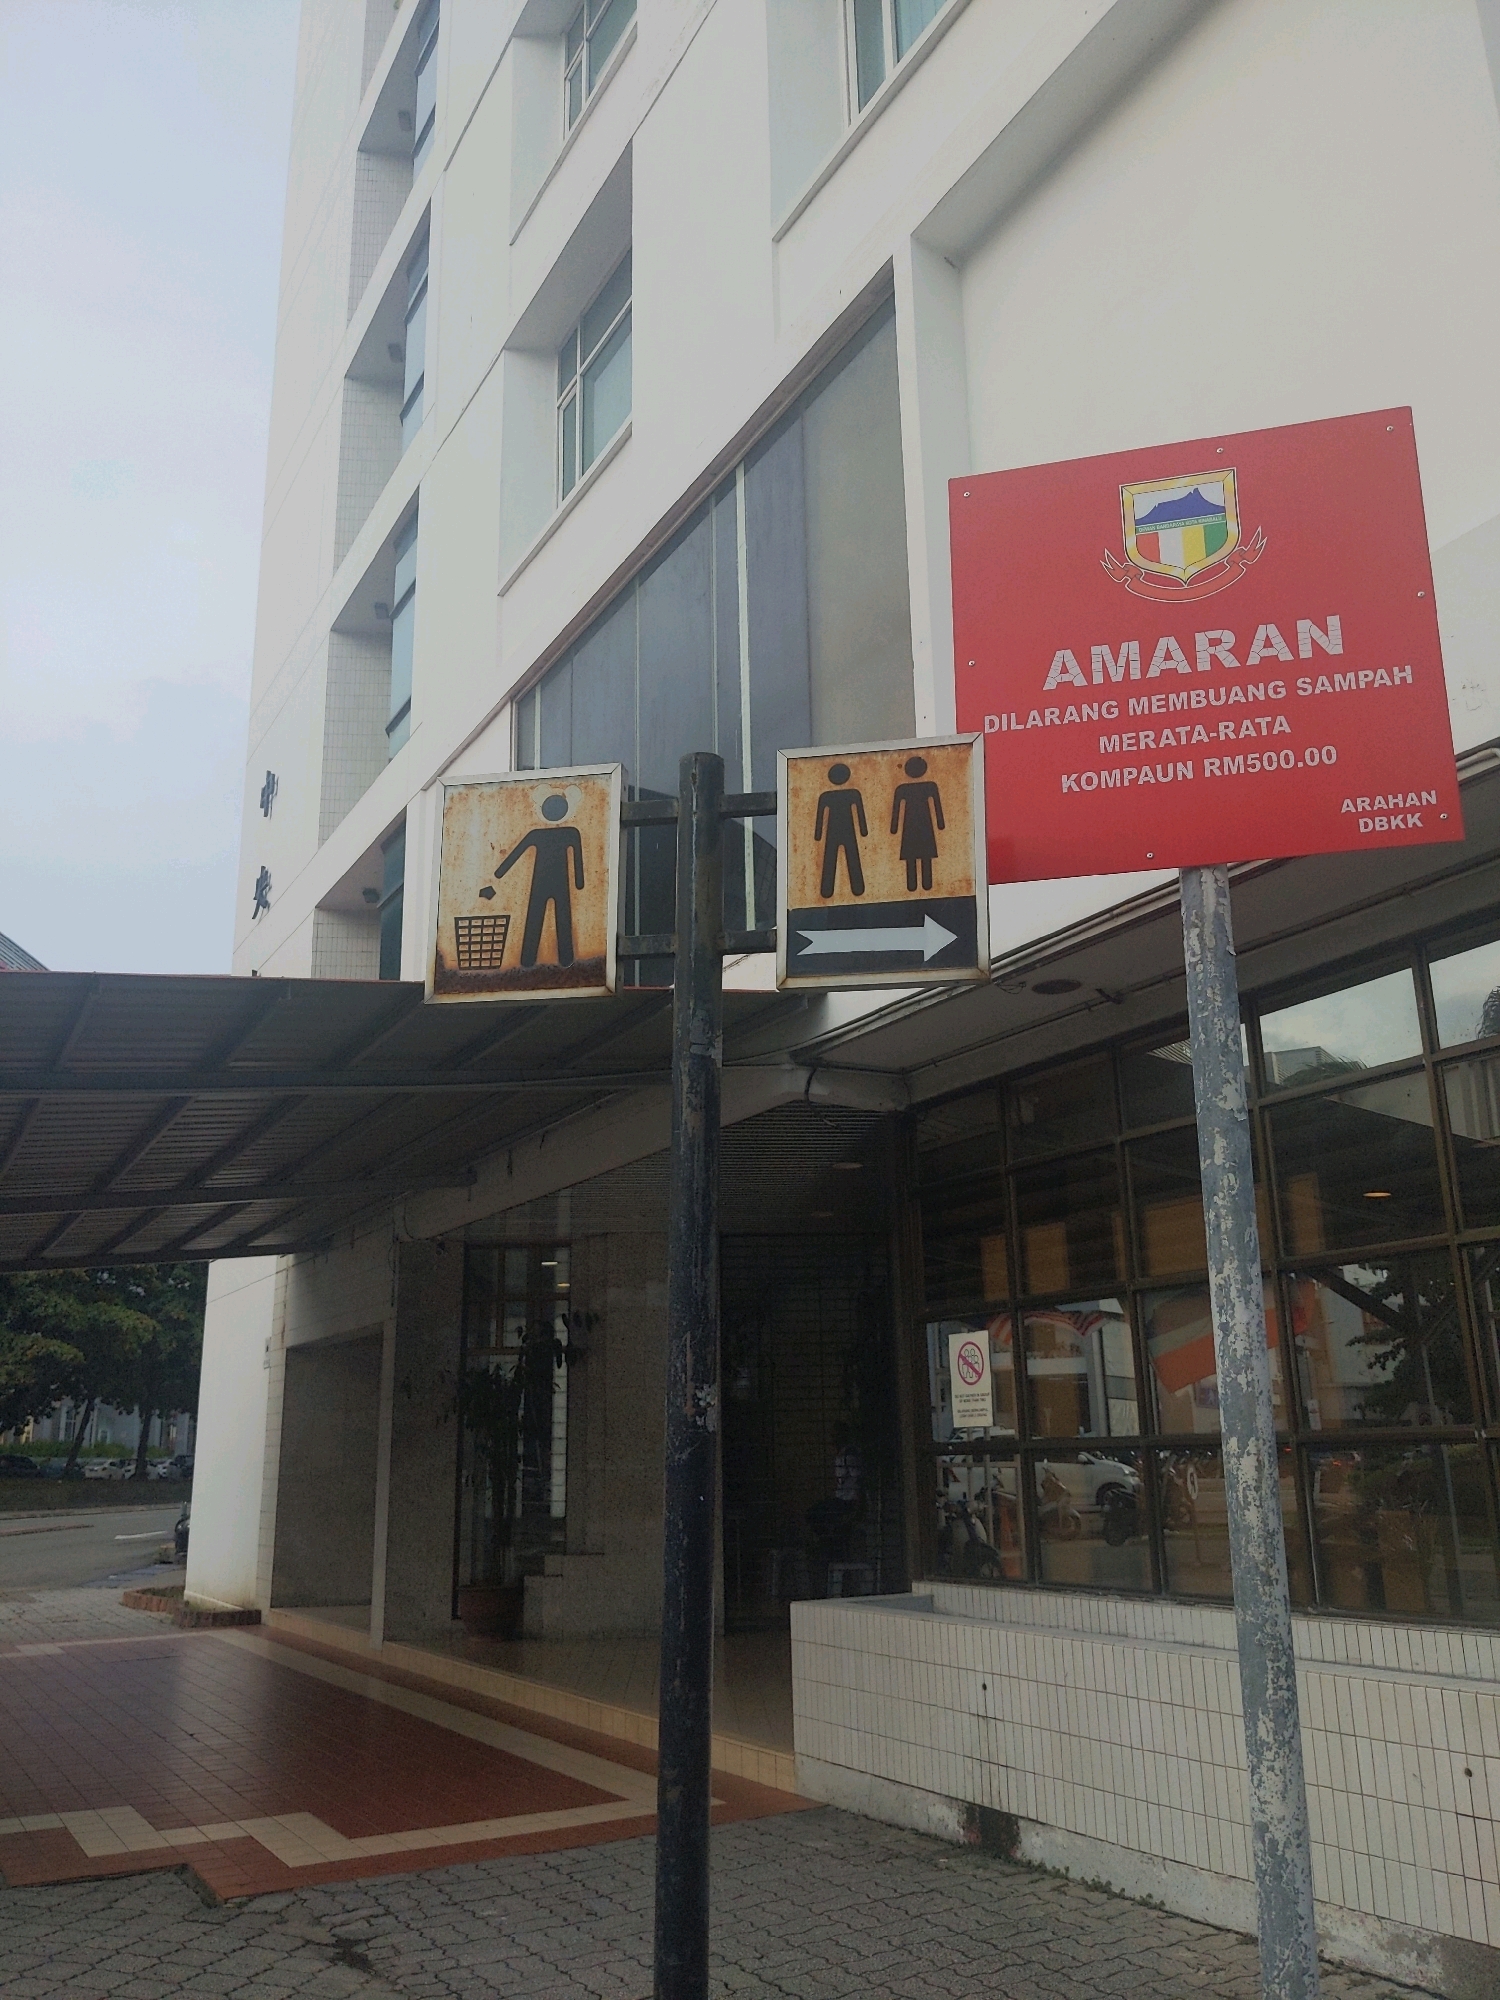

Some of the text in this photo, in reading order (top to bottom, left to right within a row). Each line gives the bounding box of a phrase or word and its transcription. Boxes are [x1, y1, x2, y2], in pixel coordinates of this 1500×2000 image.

[1042, 614, 1344, 691] AMARAN
[984, 665, 1413, 734] DILARANG MEMBUANG SAMPAH
[1099, 715, 1291, 754] MERATA-RATA
[1061, 745, 1338, 793] KOMPAUN RM500.00
[1340, 789, 1437, 814] ARAHAN
[1358, 812, 1423, 833] DBKK
